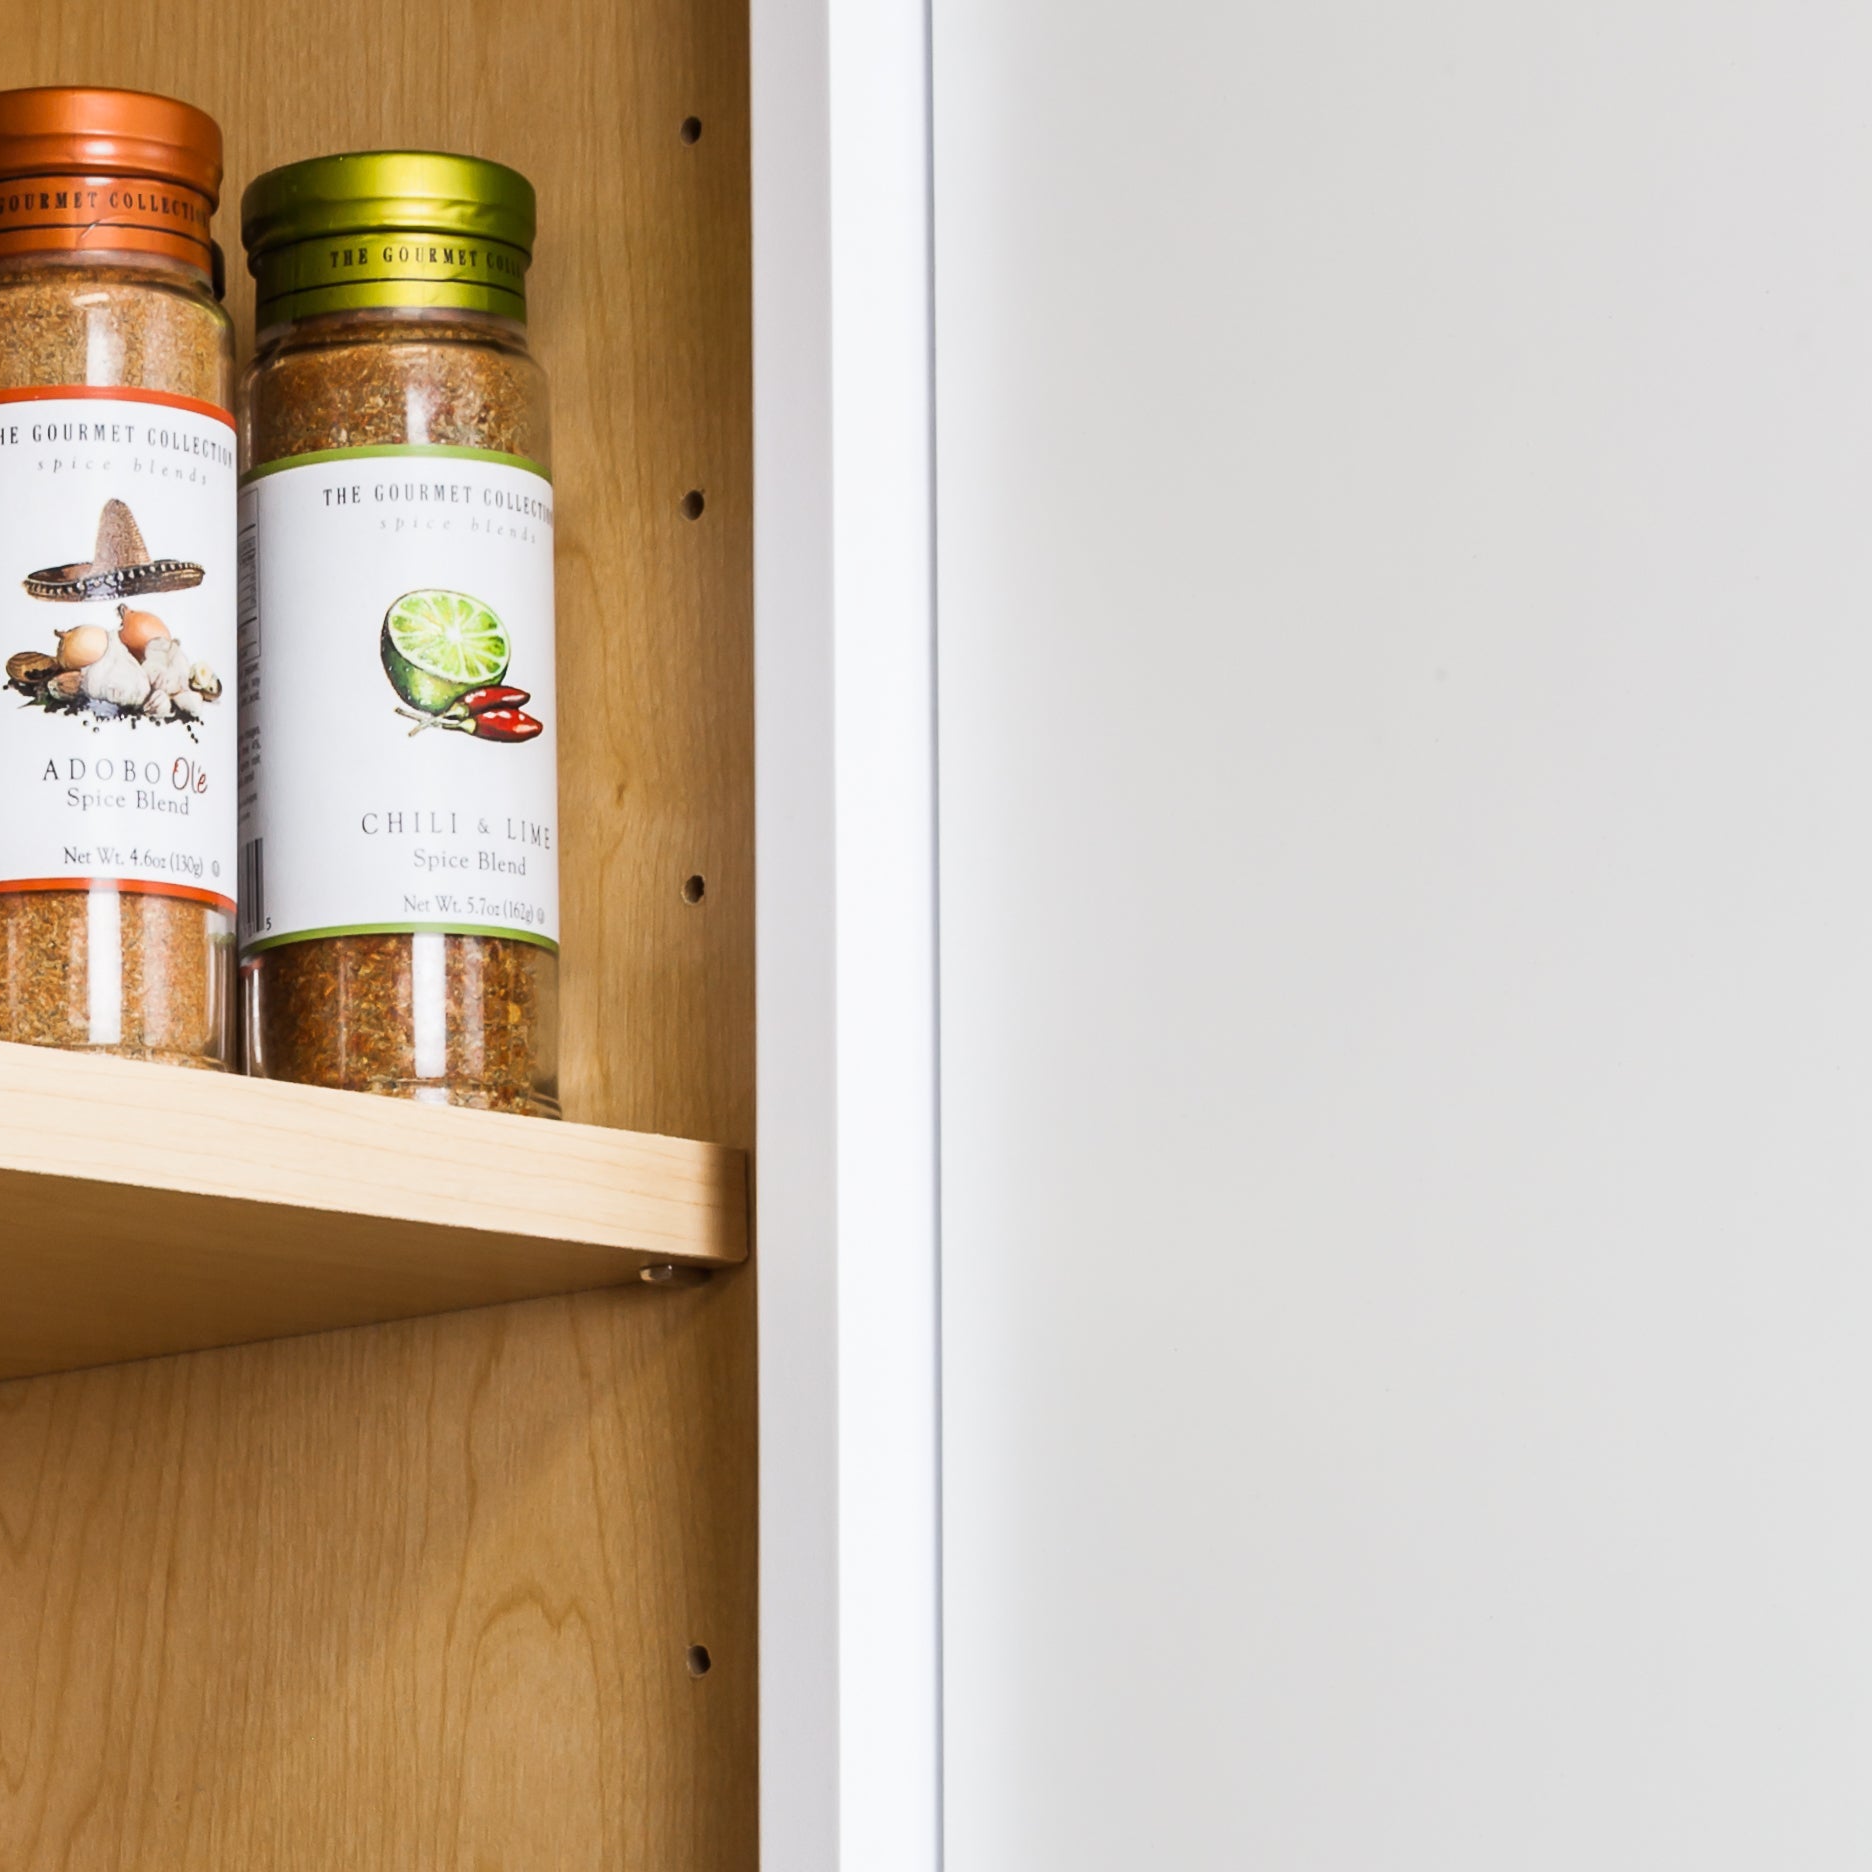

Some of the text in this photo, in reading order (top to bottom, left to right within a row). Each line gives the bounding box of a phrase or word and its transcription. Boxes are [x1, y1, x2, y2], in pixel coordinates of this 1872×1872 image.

[331, 246, 477, 268] THE GOURMET
[32, 423, 134, 443] GOURMET
[37, 455, 207, 486] spice blends
[323, 483, 472, 506] THE GOURMET
[380, 516, 536, 544] spice blends
[42, 758, 161, 784] ADOBO
[67, 787, 189, 816] Spice Blend
[361, 811, 550, 850] CHILI & LIME
[64, 846, 204, 879] Net Wt. 4.6oz (130g)
[413, 848, 526, 876] Spice Blend
[266, 917, 272, 931] 5
[403, 895, 534, 926] Net Wt. 5.7oz (162g)
